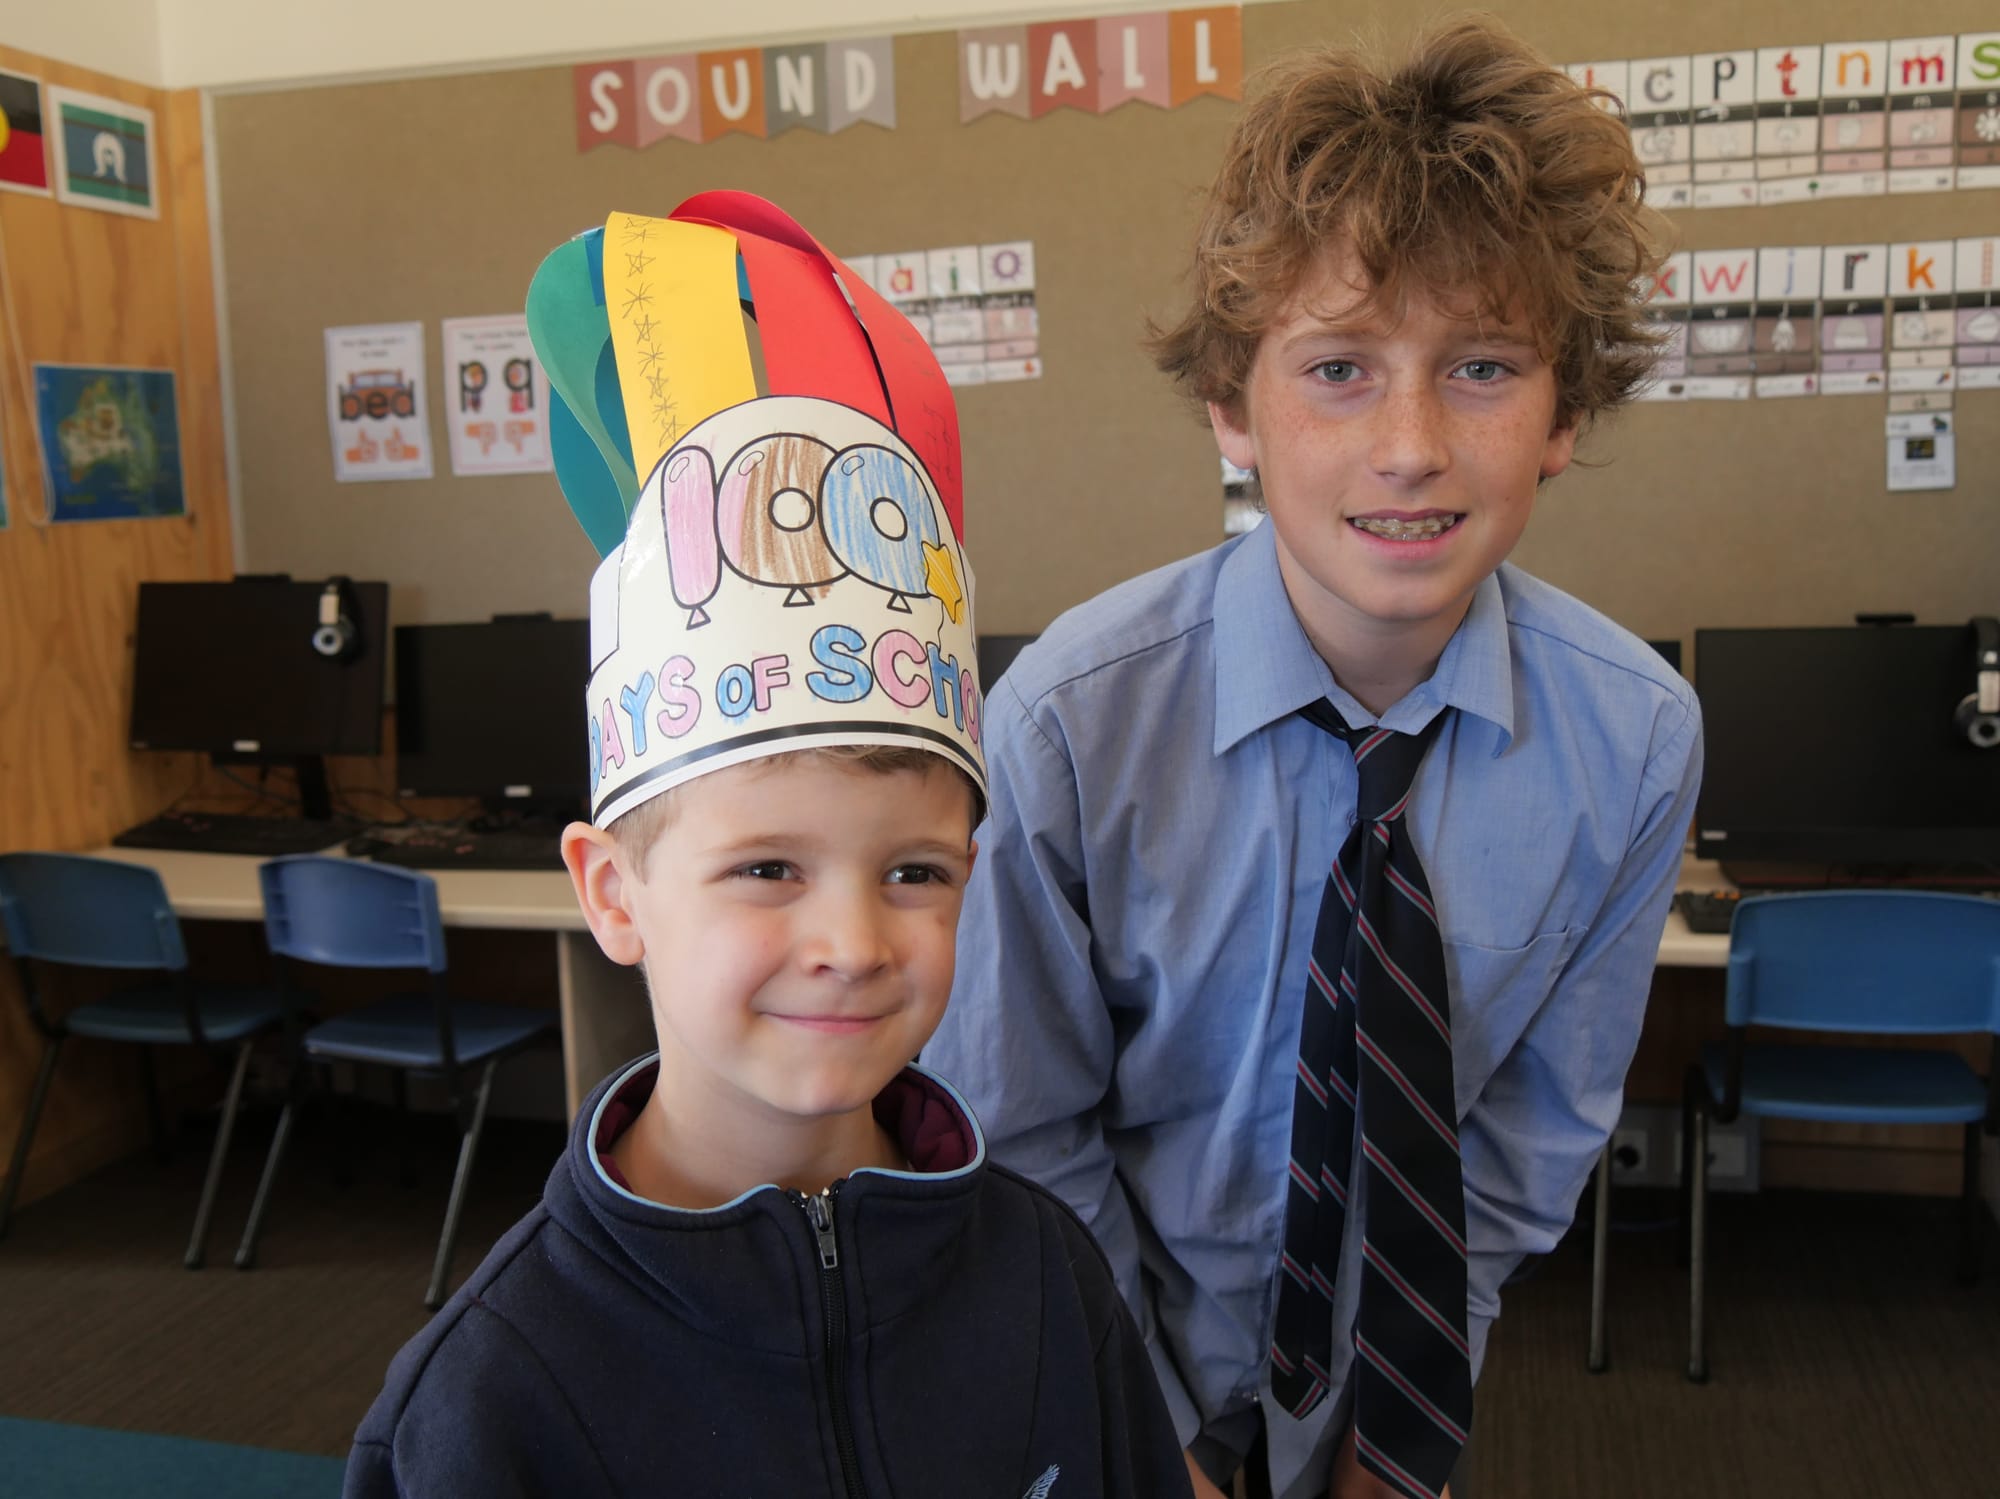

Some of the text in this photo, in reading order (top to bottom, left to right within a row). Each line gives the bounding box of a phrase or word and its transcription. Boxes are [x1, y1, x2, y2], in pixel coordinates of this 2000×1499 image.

[588, 19, 1218, 133] SOUND WALL
[1645, 67, 1674, 102] c
[1714, 57, 1736, 102] p
[1776, 50, 1798, 96] t
[1836, 49, 1871, 87] n
[1903, 55, 1944, 86] m
[890, 268, 913, 294] a
[949, 254, 959, 292] i
[1698, 261, 1748, 294] w
[1784, 248, 1796, 295] j
[1843, 251, 1869, 291] r
[1907, 246, 1936, 289] k
[660, 432, 942, 612] 100
[715, 653, 791, 718] OF
